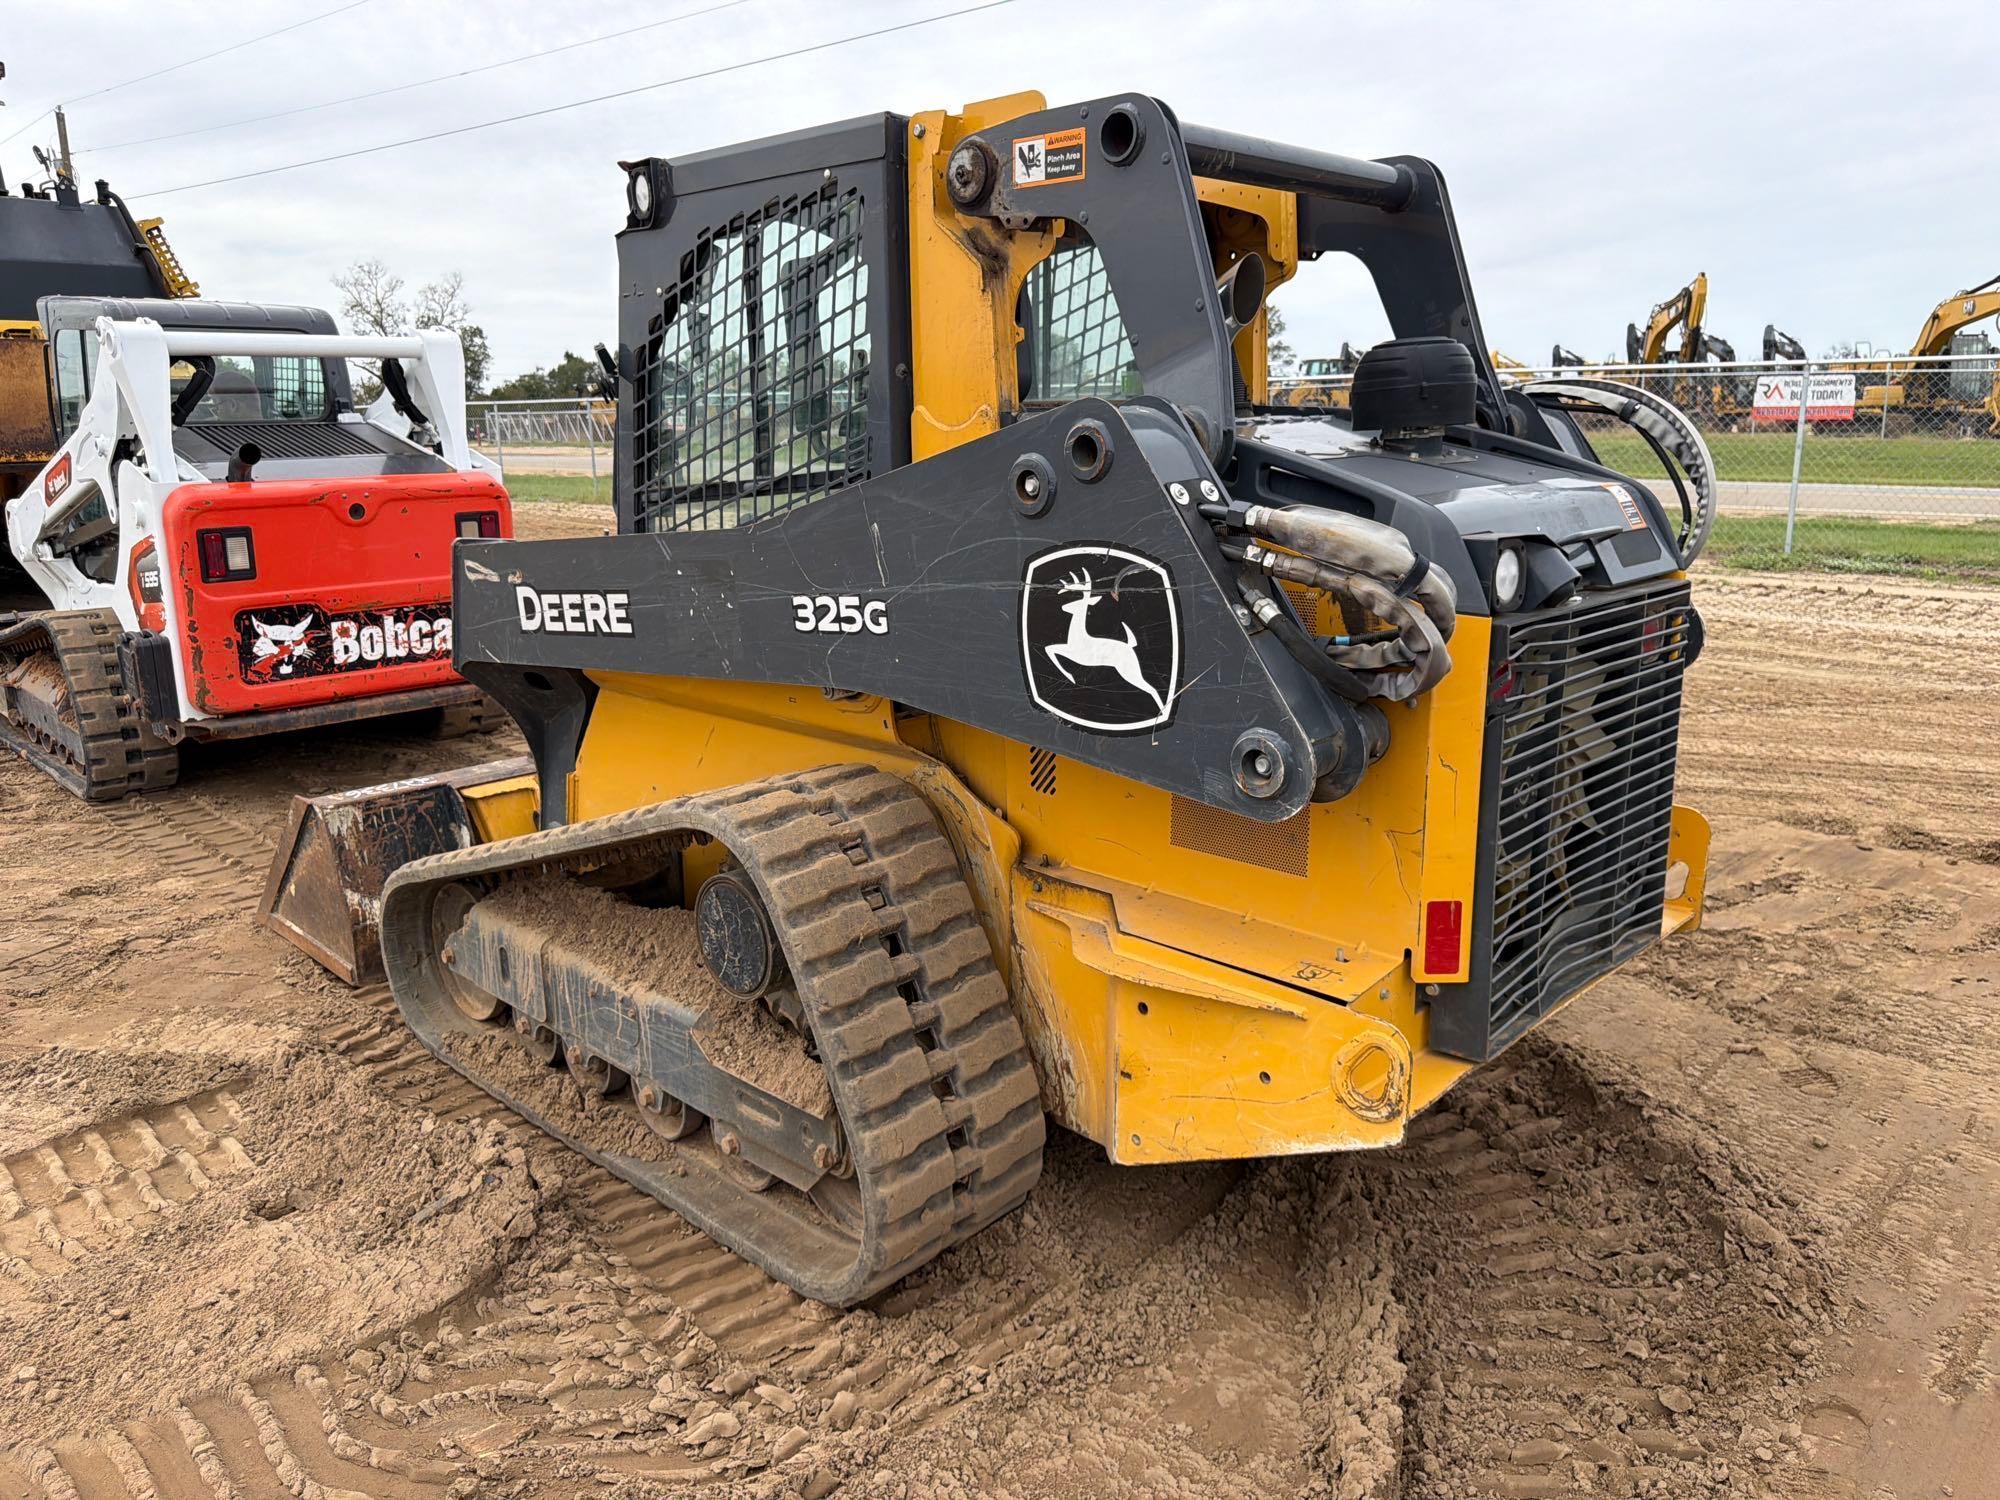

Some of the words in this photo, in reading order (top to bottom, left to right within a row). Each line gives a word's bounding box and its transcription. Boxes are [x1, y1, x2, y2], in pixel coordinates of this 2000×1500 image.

[1054, 133, 1081, 144] WARNING
[1047, 154, 1065, 164] Pinch
[1066, 152, 1081, 160] Area
[1047, 165, 1060, 174] Keep
[1061, 163, 1076, 172] Away
[1811, 389, 1843, 400] TODAY!
[516, 586, 633, 634] DEERE
[792, 595, 888, 635] 325G
[331, 613, 453, 665] Bobca
